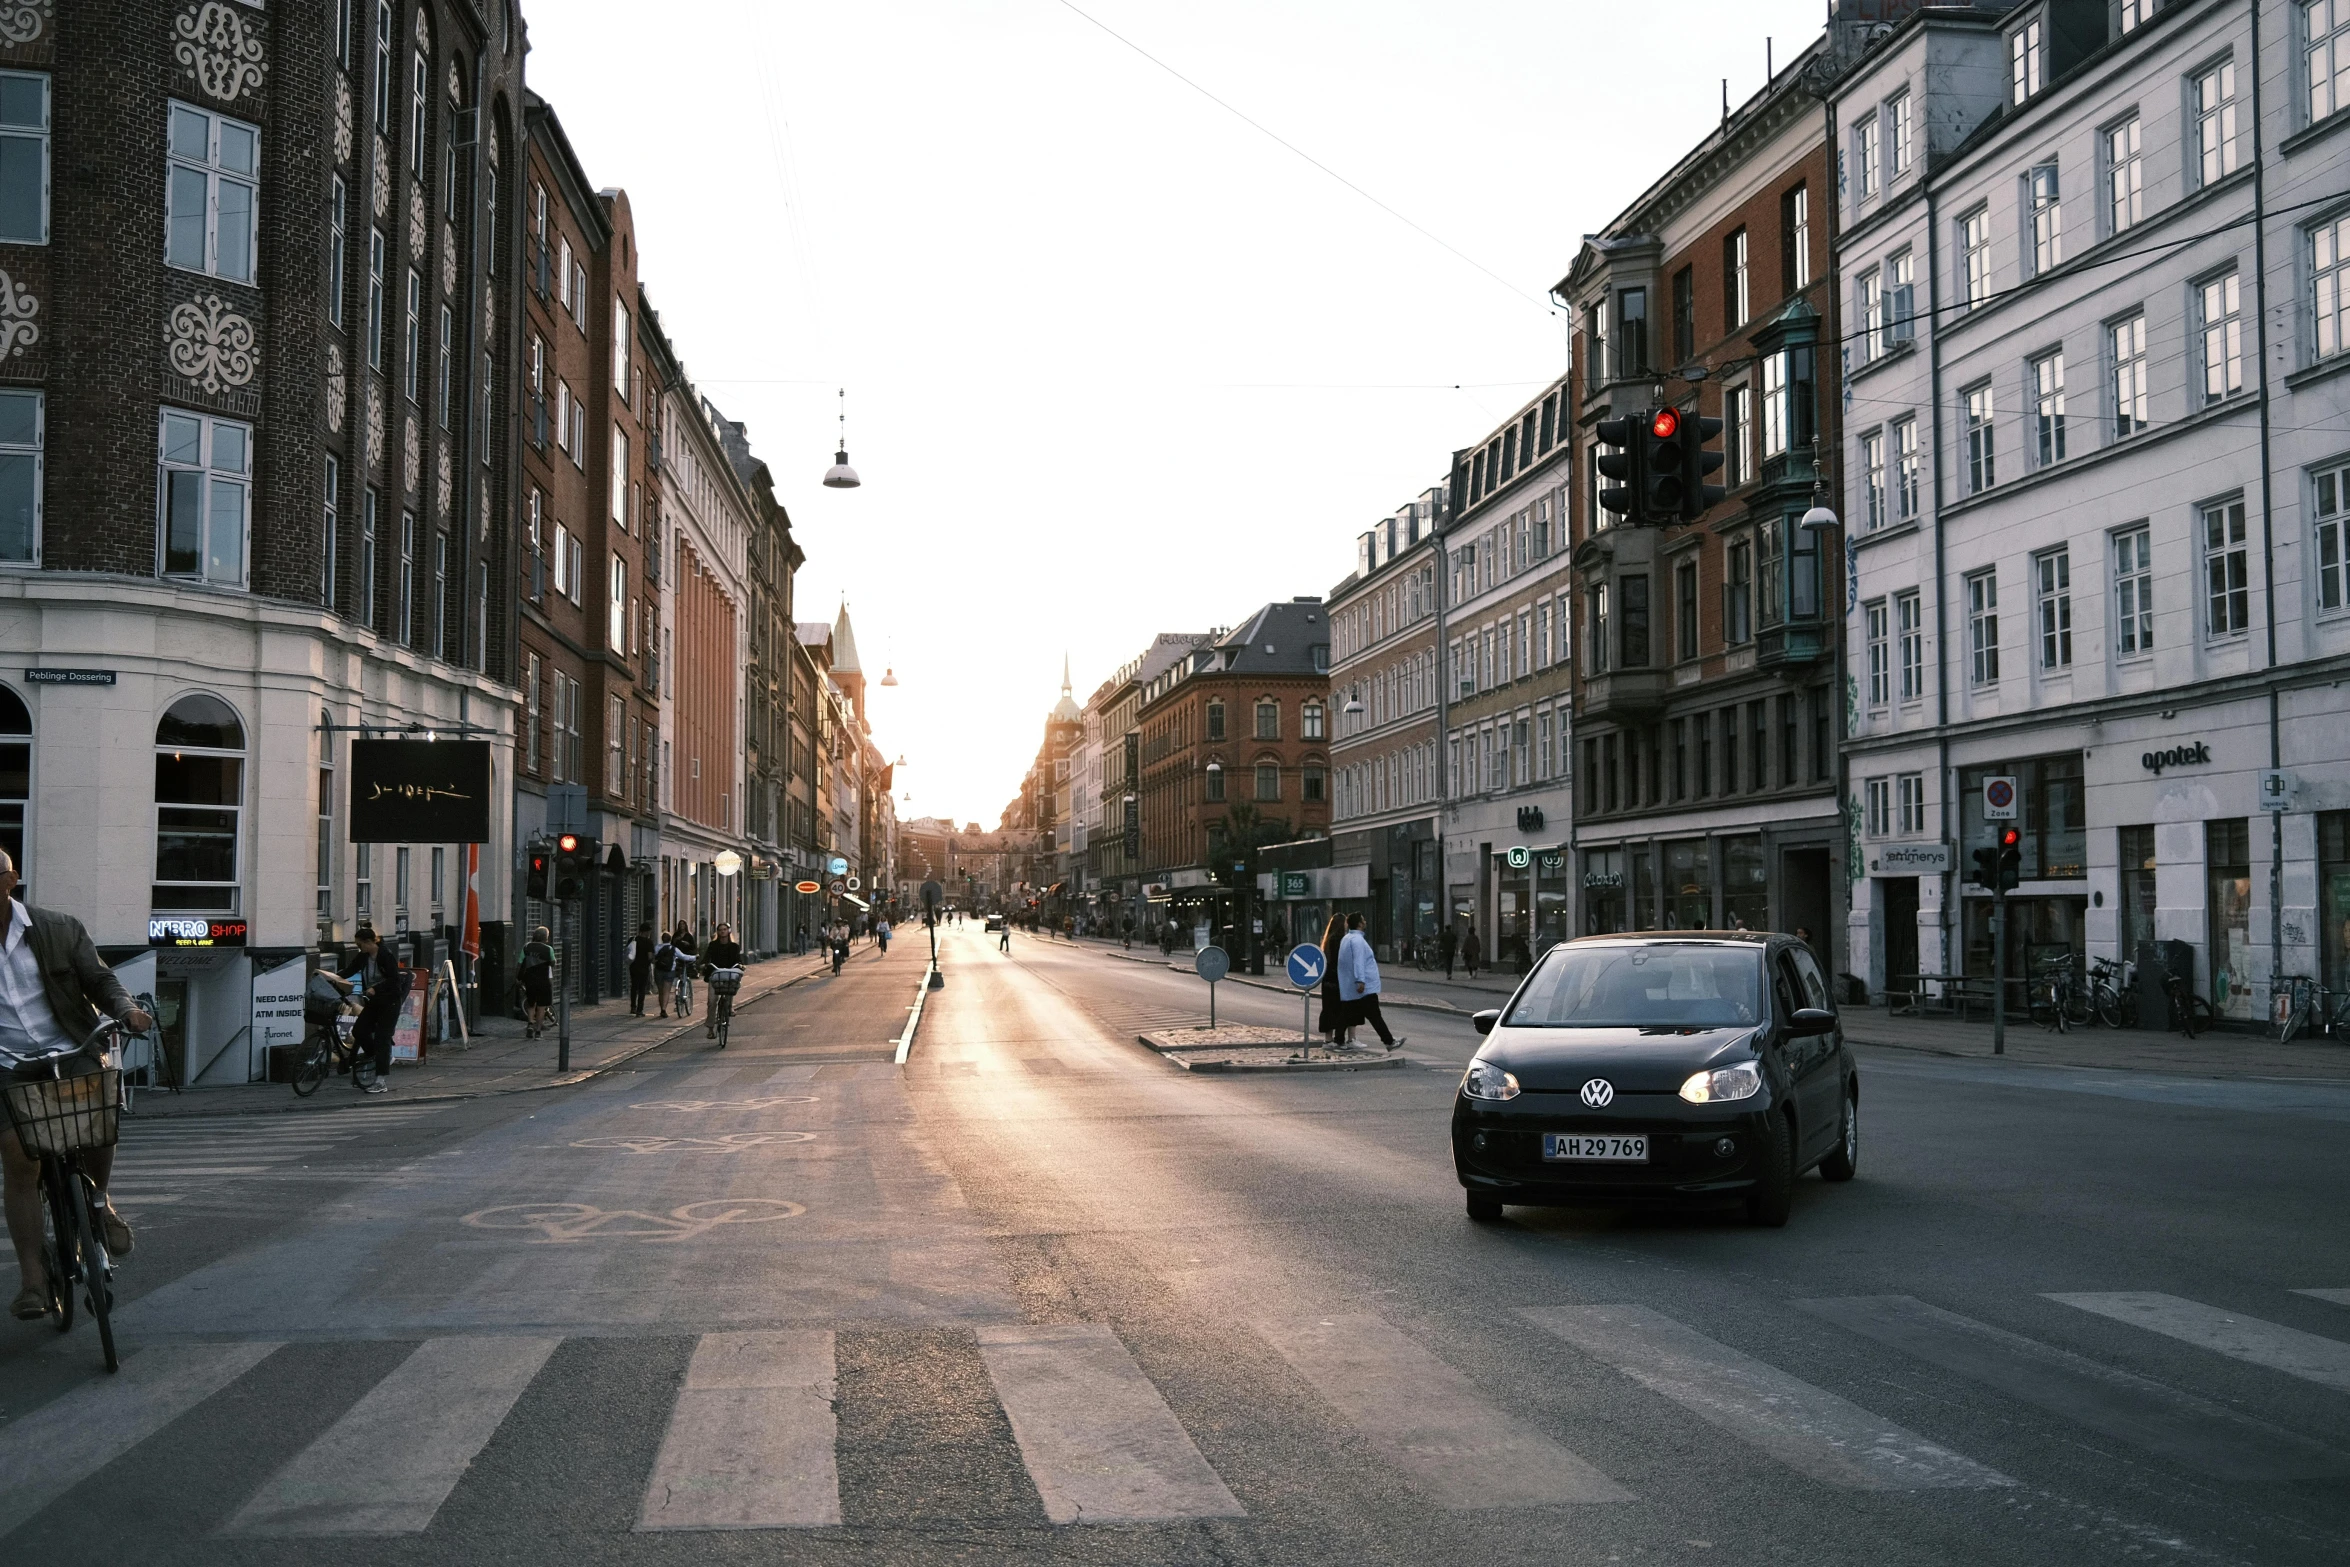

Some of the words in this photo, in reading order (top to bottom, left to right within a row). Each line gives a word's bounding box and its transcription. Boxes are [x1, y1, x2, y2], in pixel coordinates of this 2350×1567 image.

[29, 671, 67, 681] Peblinge
[69, 672, 112, 682] Dossering
[2142, 741, 2211, 775] apotek
[1128, 803, 1137, 829] Hotel
[1888, 852, 1945, 864] emmerys
[1286, 879, 1304, 889] 365
[149, 920, 208, 938] N'BRO
[211, 925, 247, 937] SHOP
[157, 955, 218, 965] WELCOME
[278, 994, 304, 1003] CASH?
[276, 1009, 302, 1017] INSIDE
[1557, 1139, 1580, 1155] AH
[1585, 1139, 1606, 1156] 29
[1611, 1139, 1645, 1157] 769
